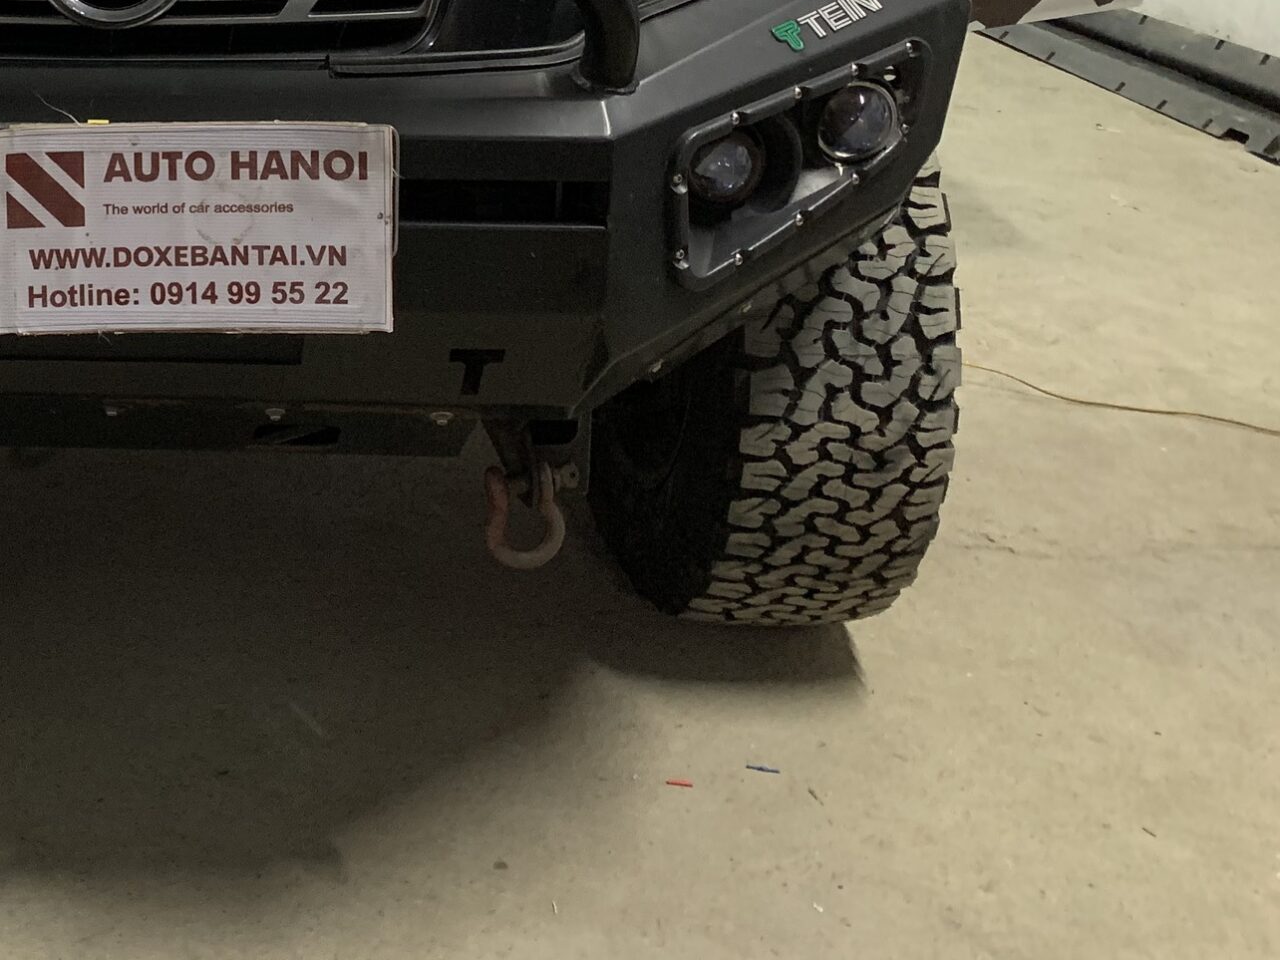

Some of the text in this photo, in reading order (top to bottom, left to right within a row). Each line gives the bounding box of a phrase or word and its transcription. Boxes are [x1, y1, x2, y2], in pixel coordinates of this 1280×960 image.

[103, 149, 369, 183] AUTO HANOI
[103, 201, 295, 216] The world of car accessories
[28, 244, 348, 271] WWW.DOXEBANTAI.VN
[28, 280, 350, 309] Hotline: 0914 99 55 22
